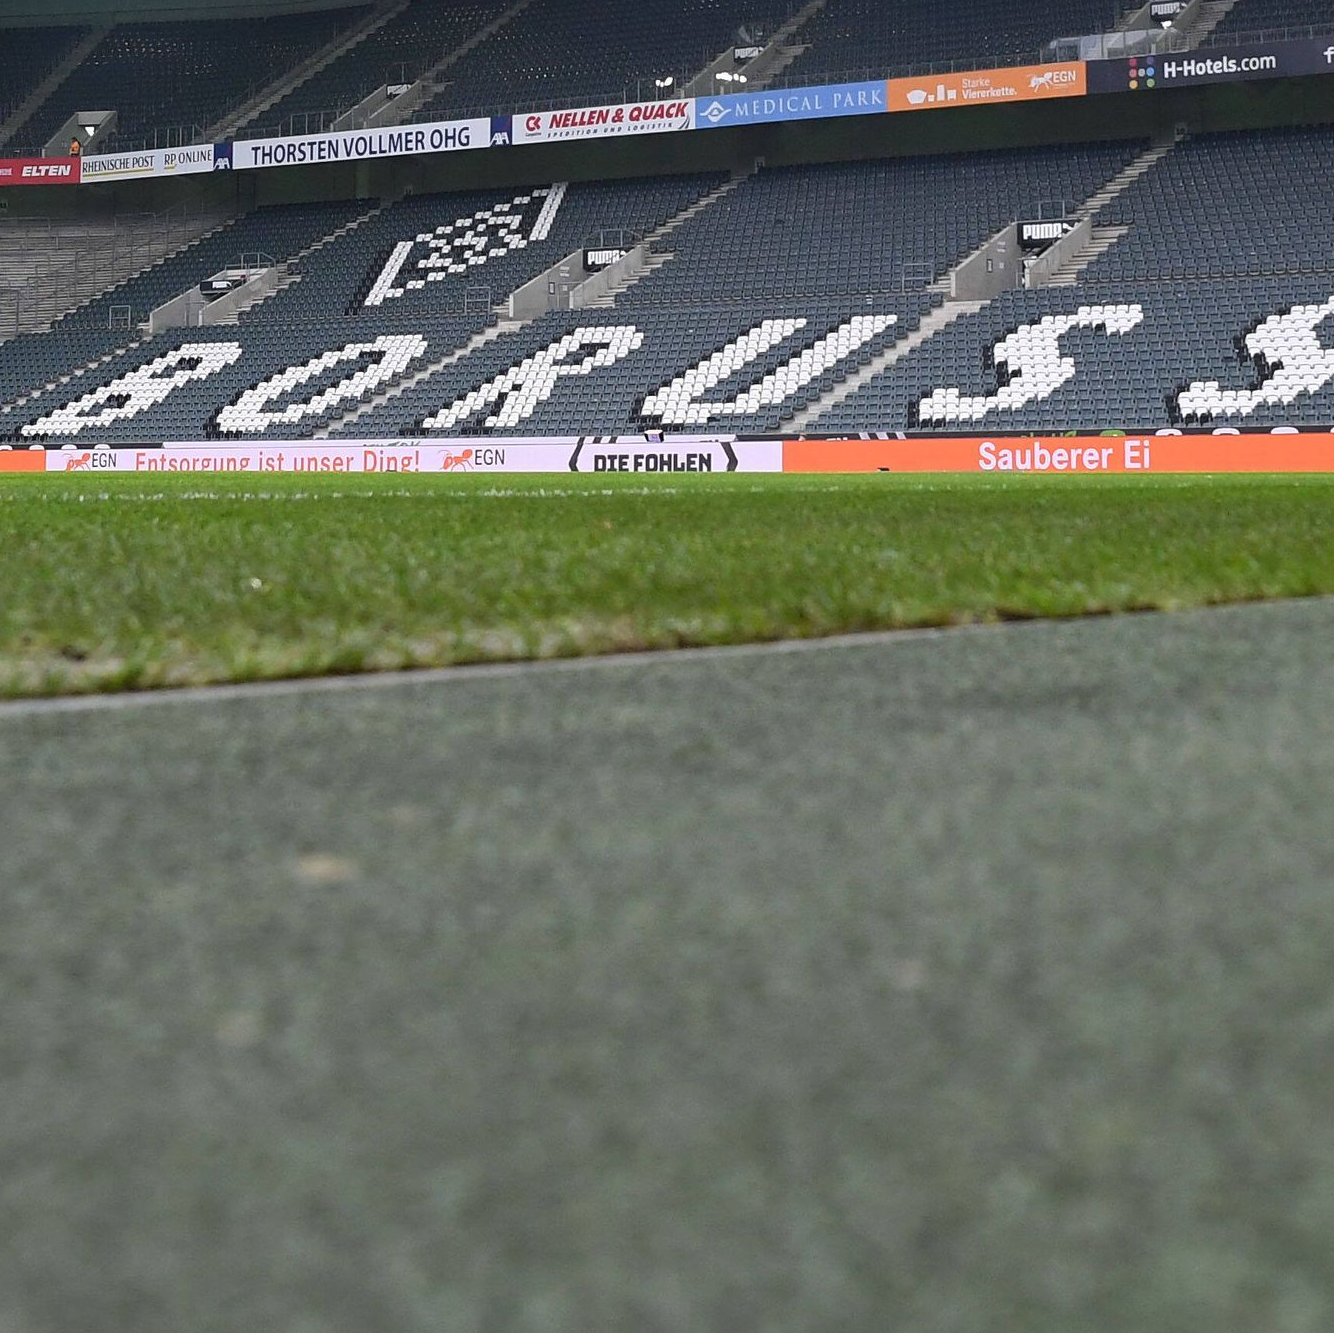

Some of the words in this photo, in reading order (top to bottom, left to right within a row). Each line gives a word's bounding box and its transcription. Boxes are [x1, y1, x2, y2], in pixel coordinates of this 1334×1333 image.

[1164, 55, 1276, 79] H-Hotels.com
[962, 78, 991, 89] Starke
[1052, 70, 1076, 83] EGN
[962, 86, 1017, 100] Viererkette.
[735, 95, 822, 117] MEDICAL
[833, 89, 883, 108] PARK
[549, 109, 610, 129] NELLEN
[611, 107, 624, 123] &
[629, 102, 689, 123] QUACK
[547, 128, 598, 138] SPEDITION
[603, 126, 622, 134] UND
[627, 122, 673, 132] LOGISTIK
[251, 139, 339, 165] THORSTEN
[343, 130, 425, 157] VOLLMER
[430, 127, 470, 149] OHG
[82, 157, 131, 173] RHEINISCHE
[132, 155, 155, 168] POST
[164, 153, 176, 165] RP
[178, 149, 212, 164] ONLINE
[22, 165, 71, 177] ELTEN
[1023, 223, 1063, 240] PUMA
[91, 453, 117, 468] EGN
[136, 452, 250, 471] Entsorgung
[258, 451, 284, 471] ist
[293, 456, 355, 472] unser
[363, 450, 420, 472] Ding!
[474, 449, 505, 466] EGN
[594, 454, 629, 471] DIE
[633, 453, 712, 471] FOHLEN
[978, 440, 1113, 471] Sauberer
[1124, 439, 1150, 469] Ei
